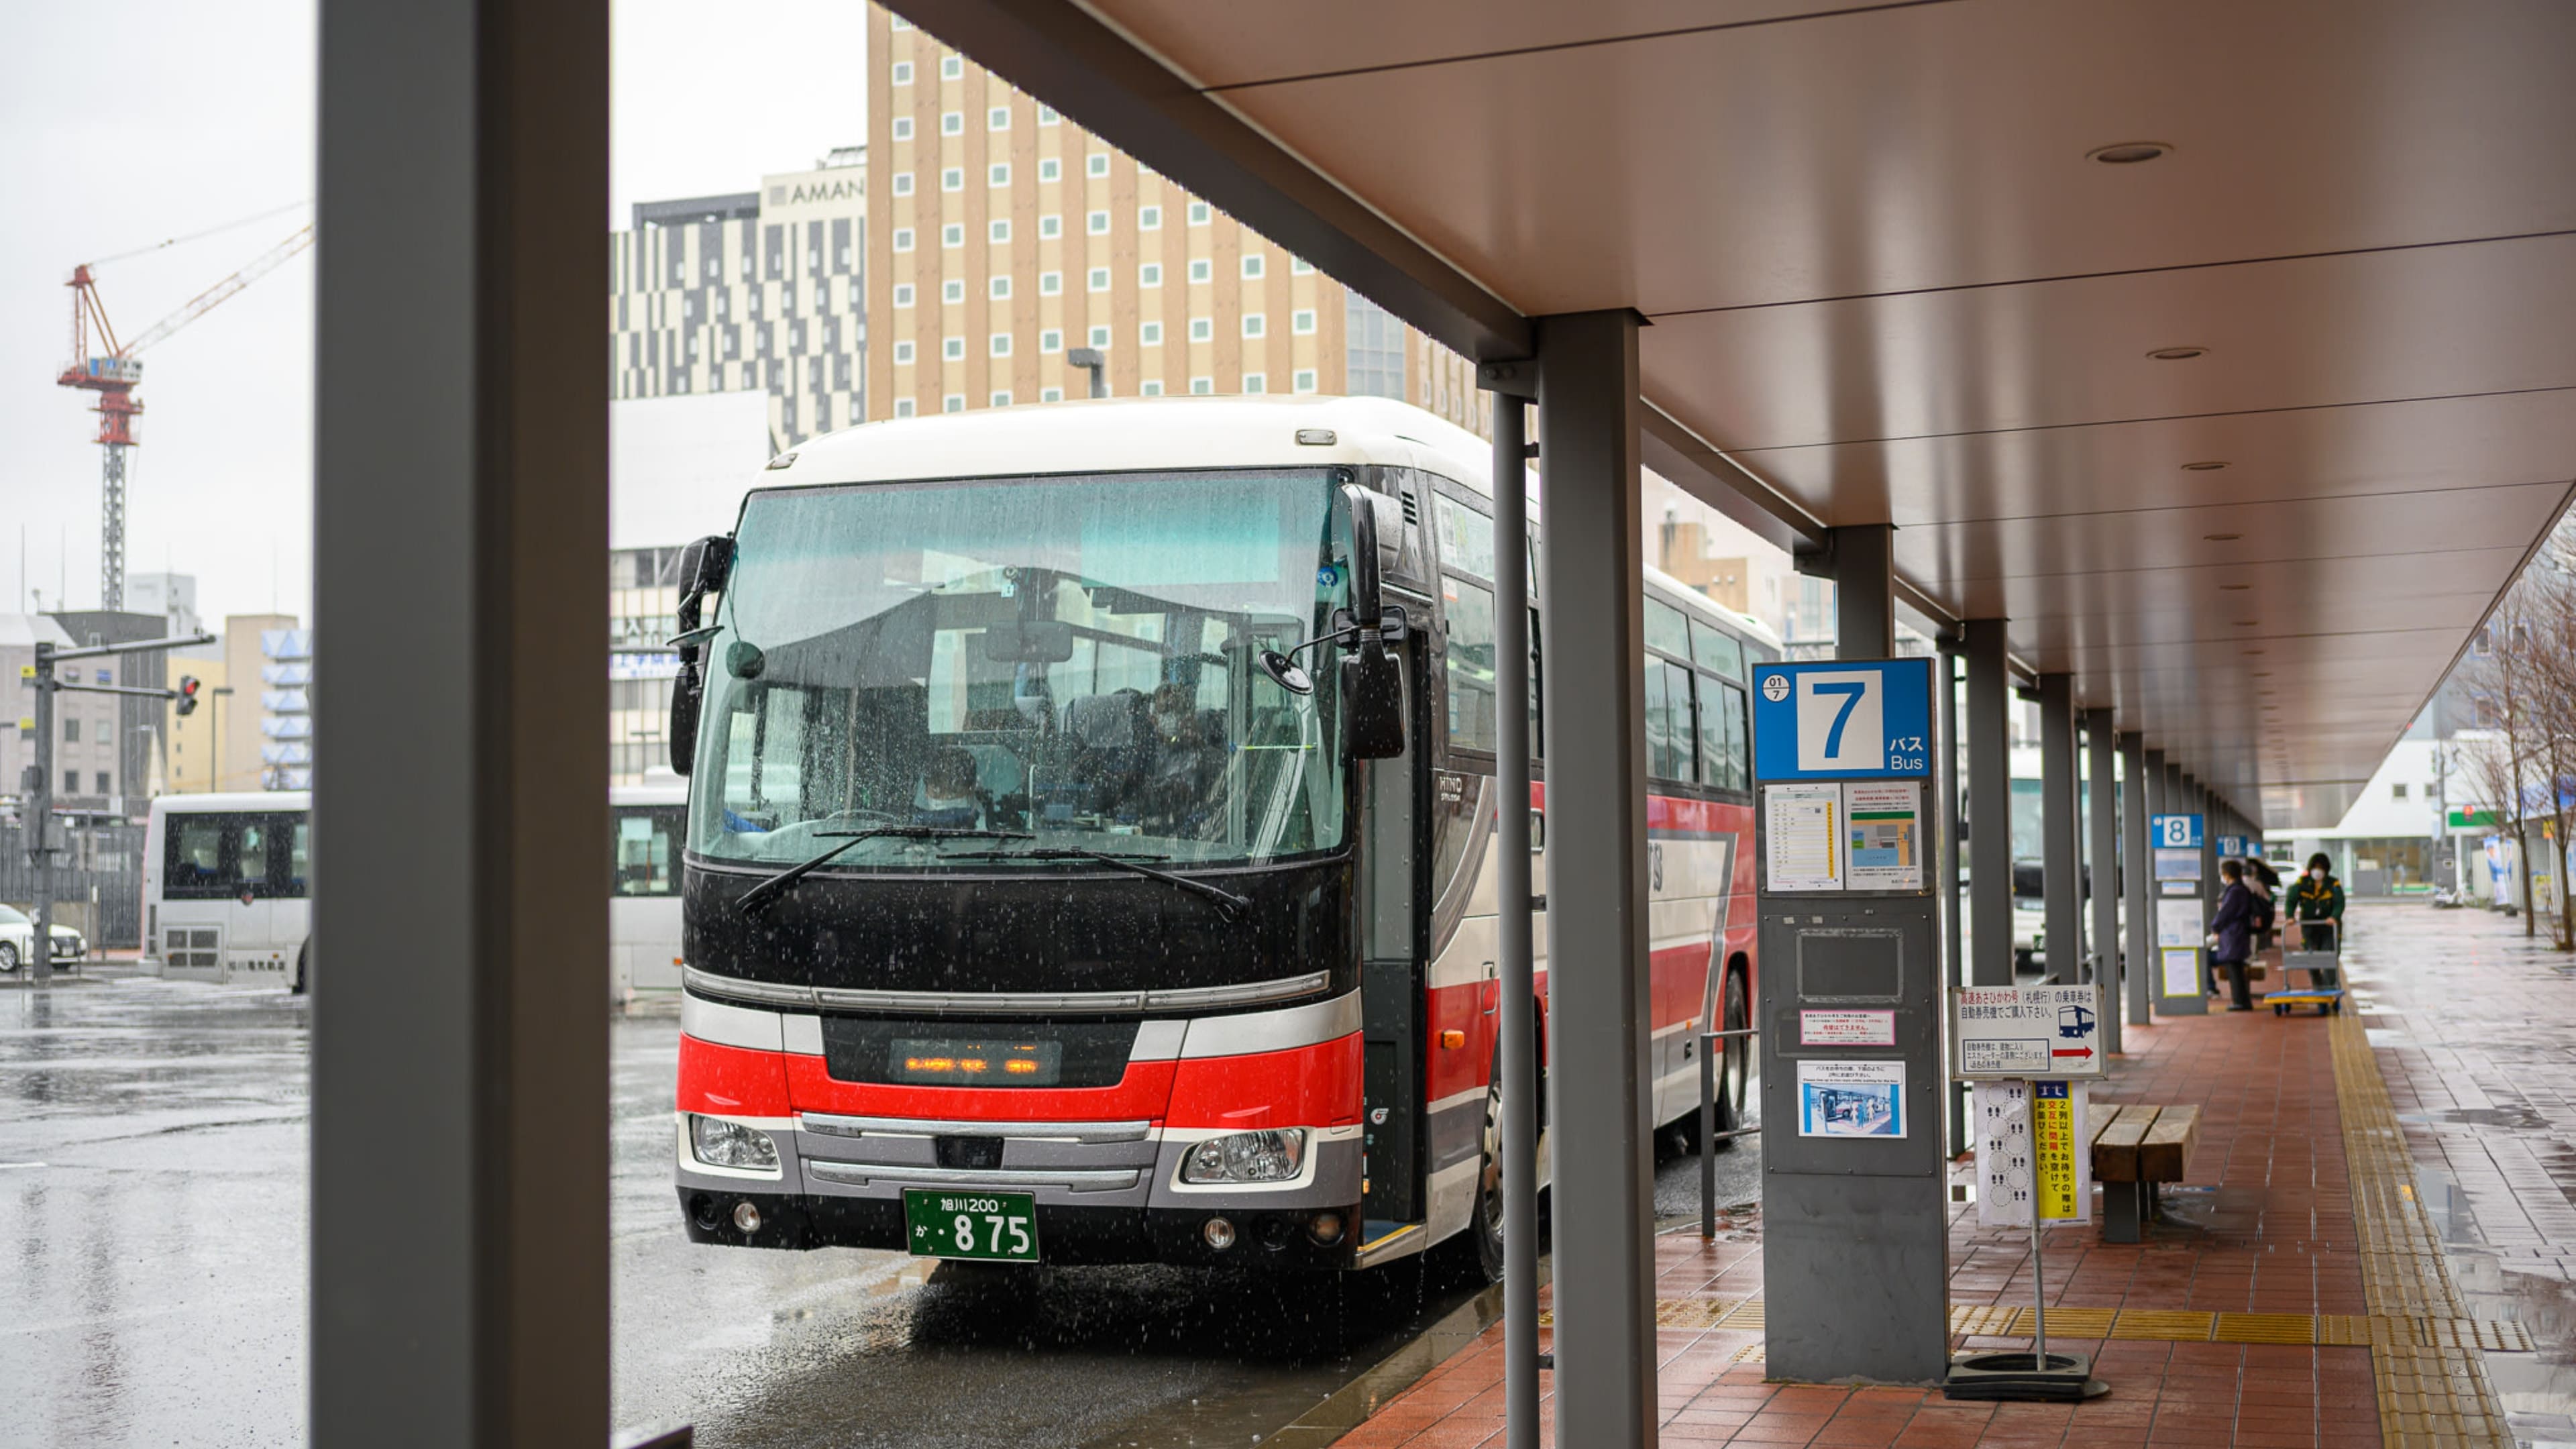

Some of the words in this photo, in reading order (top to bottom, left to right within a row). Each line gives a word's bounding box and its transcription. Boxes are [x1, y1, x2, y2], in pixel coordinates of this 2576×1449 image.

[792, 178, 863, 203] AMAN
[1768, 677, 1782, 687] 01
[1773, 690, 1780, 700] 7
[1812, 682, 1866, 758] 7
[1890, 737, 1923, 751] バス
[1890, 755, 1923, 771] Bus
[1439, 776, 1462, 793] HINO
[2169, 820, 2185, 842] 8
[2037, 1101, 2048, 1175] お並びください。
[2059, 1101, 2071, 1212] 2列以上でお待ちの際は
[915, 1225, 928, 1238] か
